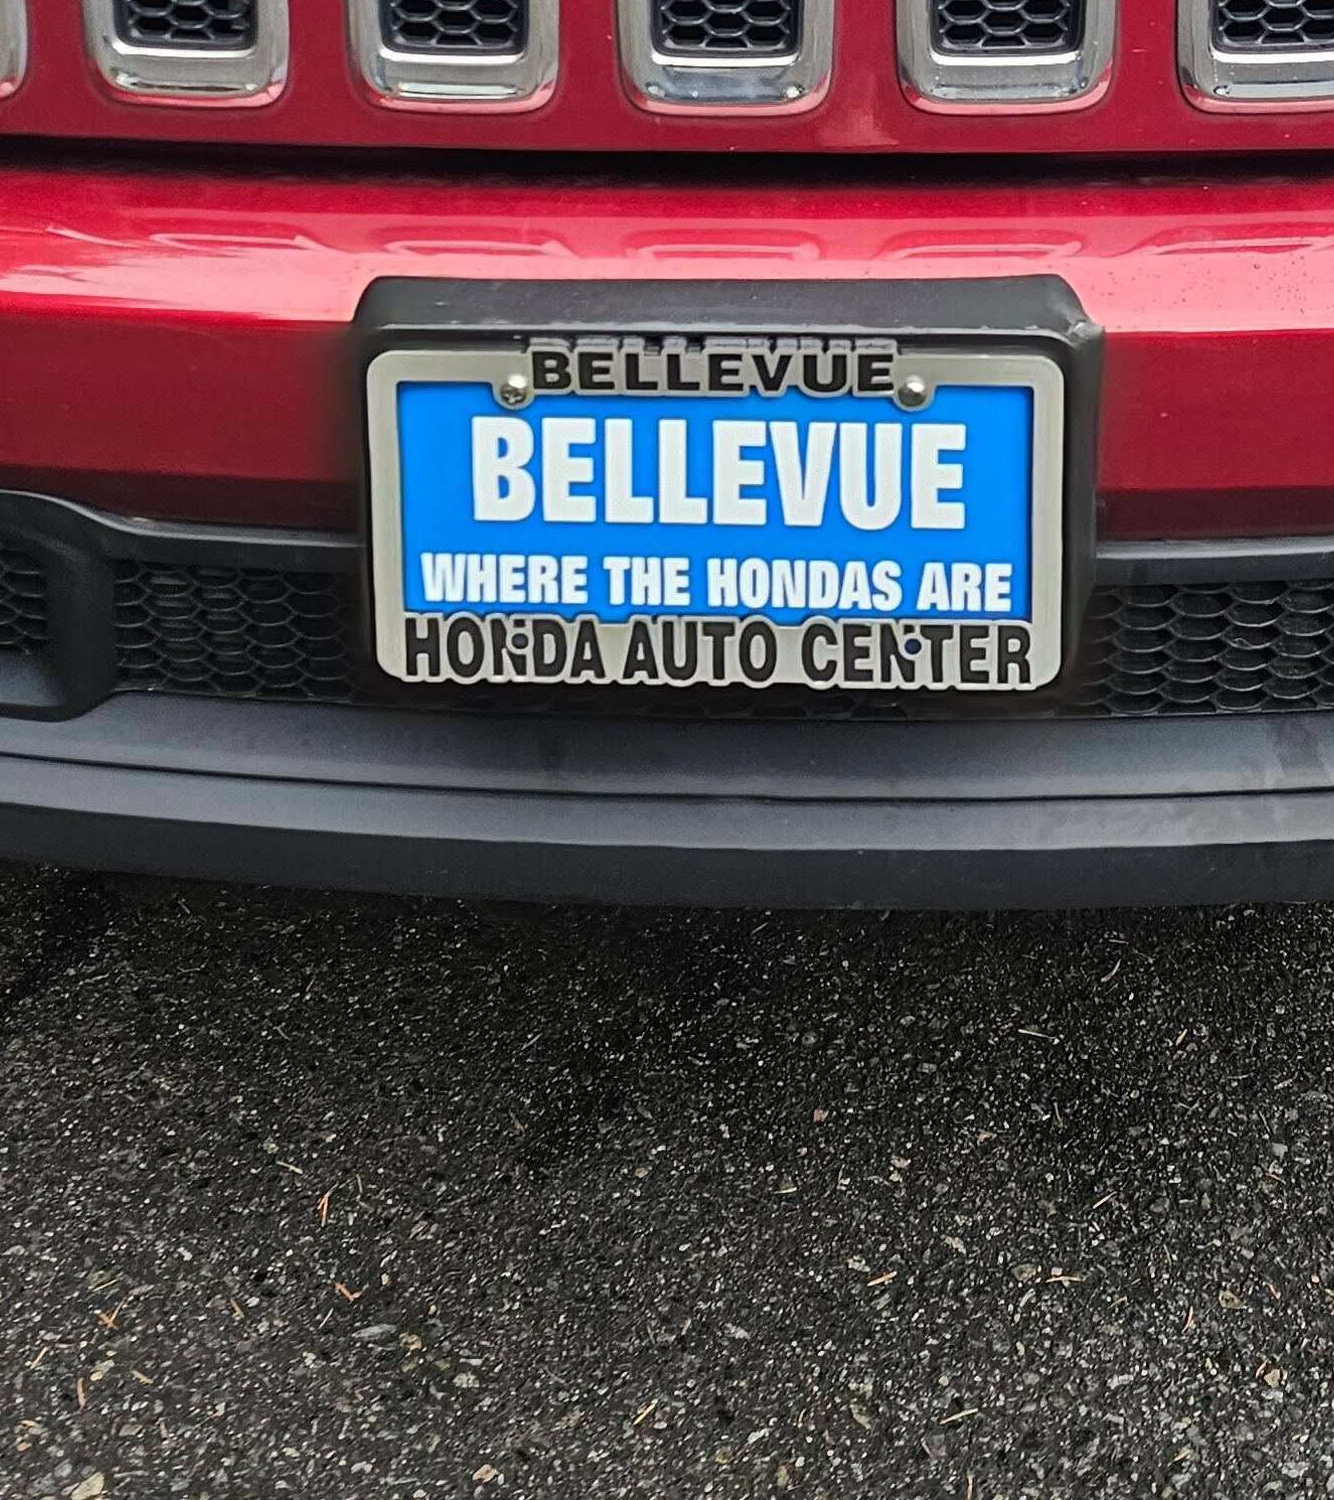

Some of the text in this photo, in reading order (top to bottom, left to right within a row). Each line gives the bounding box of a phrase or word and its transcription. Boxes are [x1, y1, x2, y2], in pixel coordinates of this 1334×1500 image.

[531, 350, 896, 394] BELLEVUE
[471, 415, 967, 530] BELLEVUE
[420, 552, 1014, 613] WHERE THE HONDAS ARE
[403, 616, 1033, 686] HONDA AUTO CENTER
